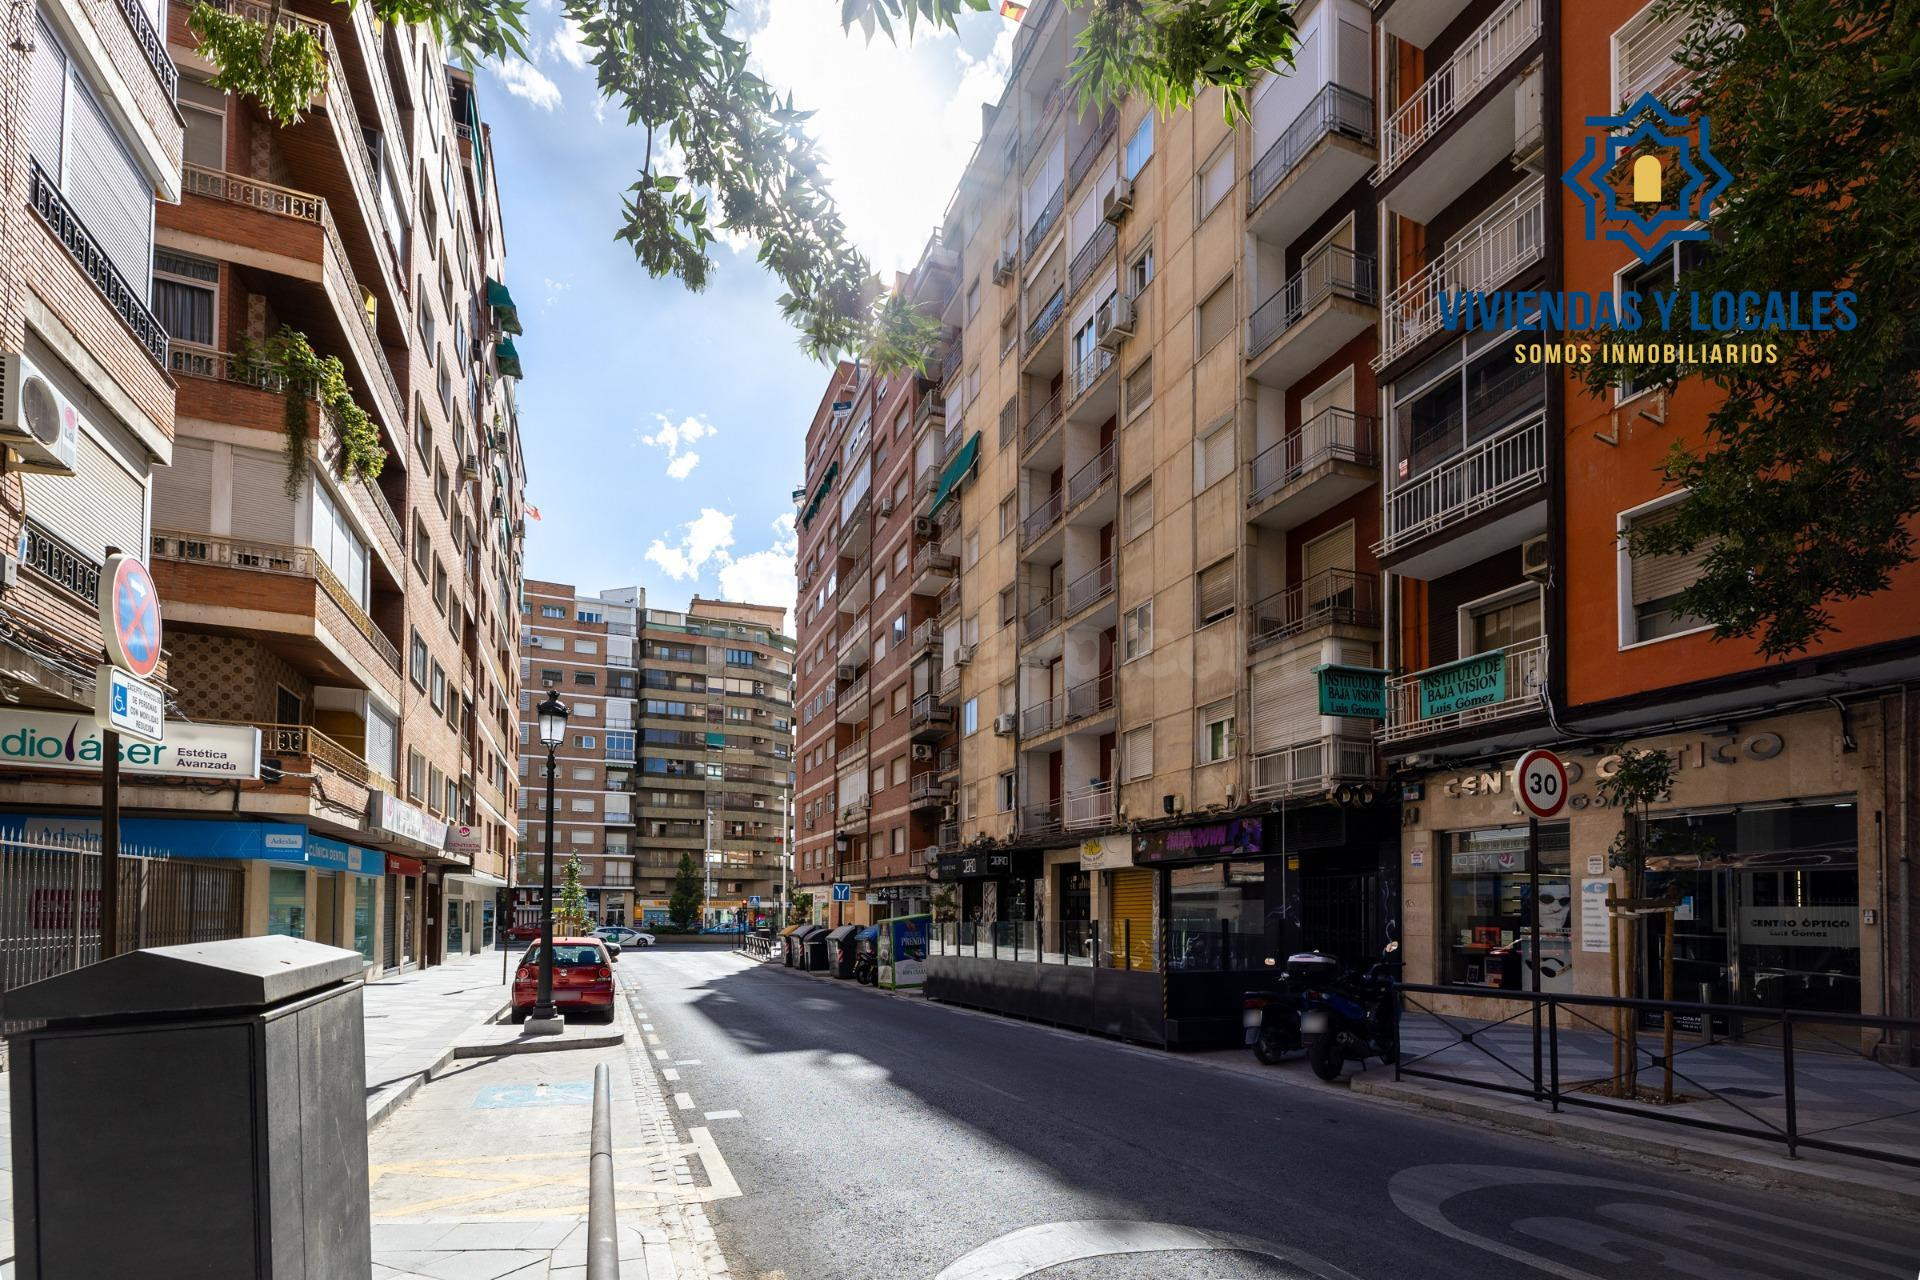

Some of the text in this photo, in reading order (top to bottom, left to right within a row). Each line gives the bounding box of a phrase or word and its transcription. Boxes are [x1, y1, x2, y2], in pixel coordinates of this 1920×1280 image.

[1325, 672, 1384, 690] INSTITUTO DE
[1423, 660, 1501, 690] INSTITUTO DE
[1328, 686, 1350, 700] BAJA
[1428, 686, 1455, 702] BAJA
[132, 696, 138, 705] DE
[1331, 701, 1349, 713] Luis
[1430, 693, 1495, 715] Luis Gómez
[130, 706, 139, 716] CON
[135, 720, 155, 733] REDUCIDA
[177, 747, 228, 760] Estética
[176, 758, 237, 771] Avanzada
[1530, 772, 1558, 795] 30
[329, 848, 347, 863] DENTAL
[1802, 917, 1850, 928] ÓPTICO
